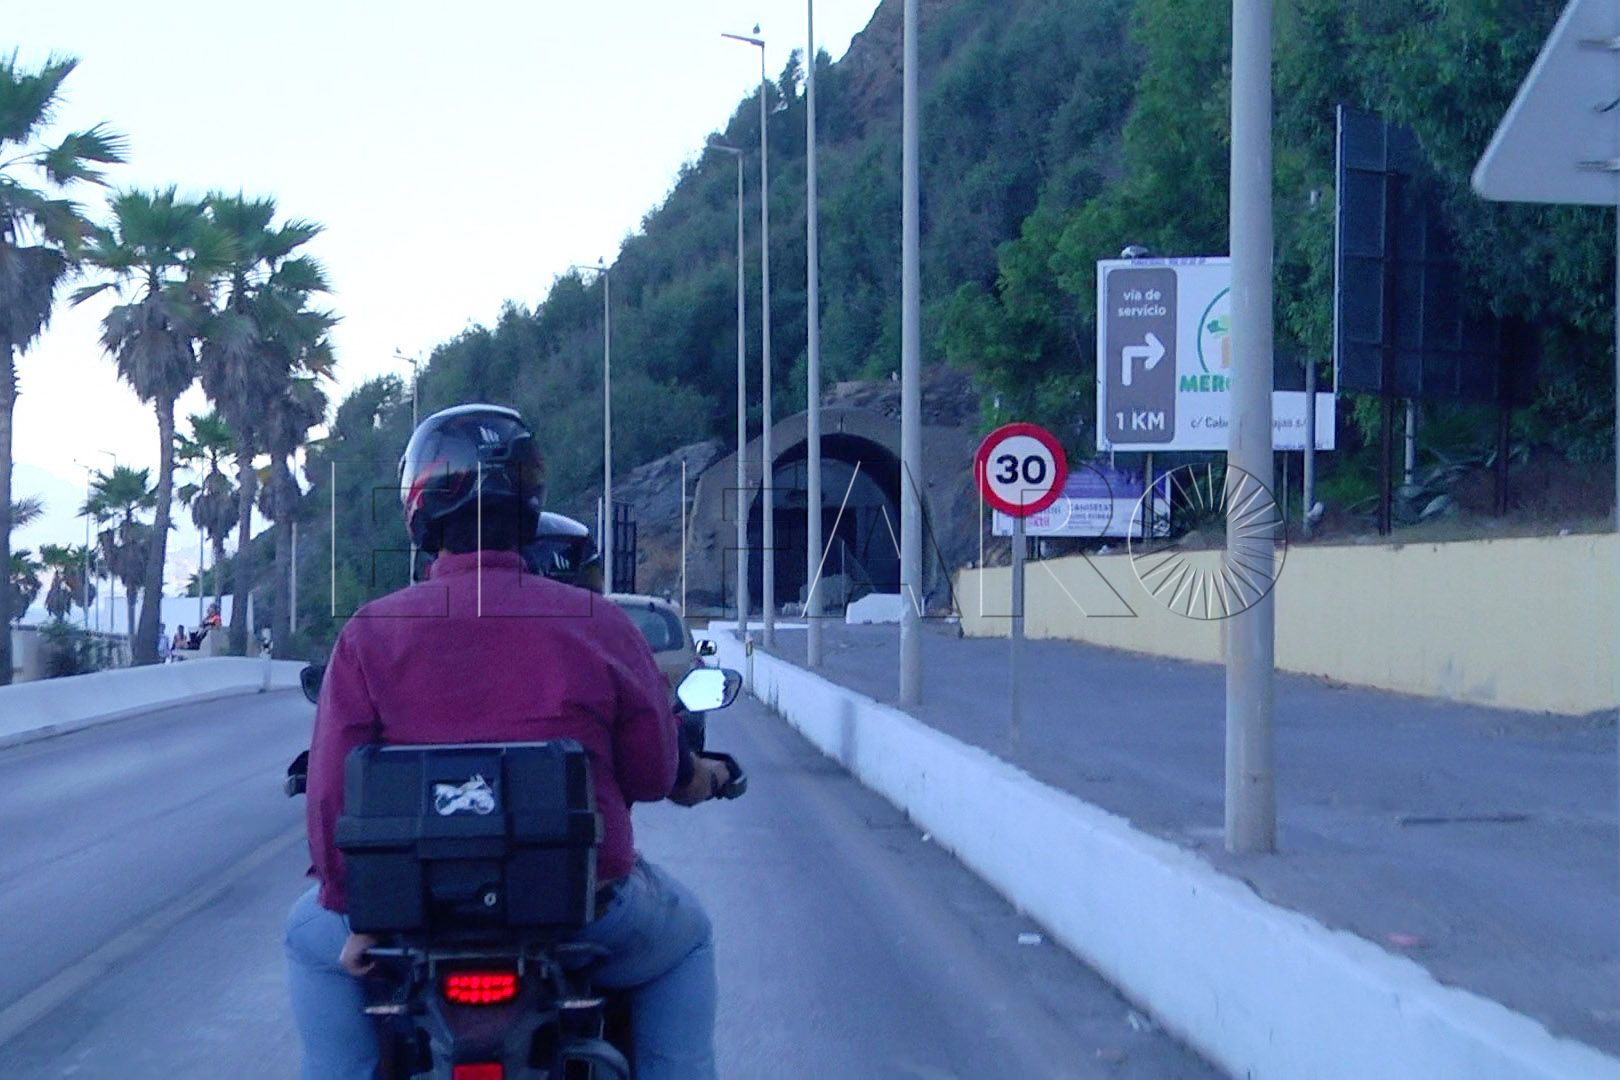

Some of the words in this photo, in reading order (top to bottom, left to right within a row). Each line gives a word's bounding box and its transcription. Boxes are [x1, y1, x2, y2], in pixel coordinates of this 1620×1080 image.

[1145, 288, 1161, 300] de
[1118, 303, 1167, 316] servicio
[1115, 411, 1125, 429] 1
[1132, 411, 1165, 430] KM
[995, 454, 1046, 484] 30
